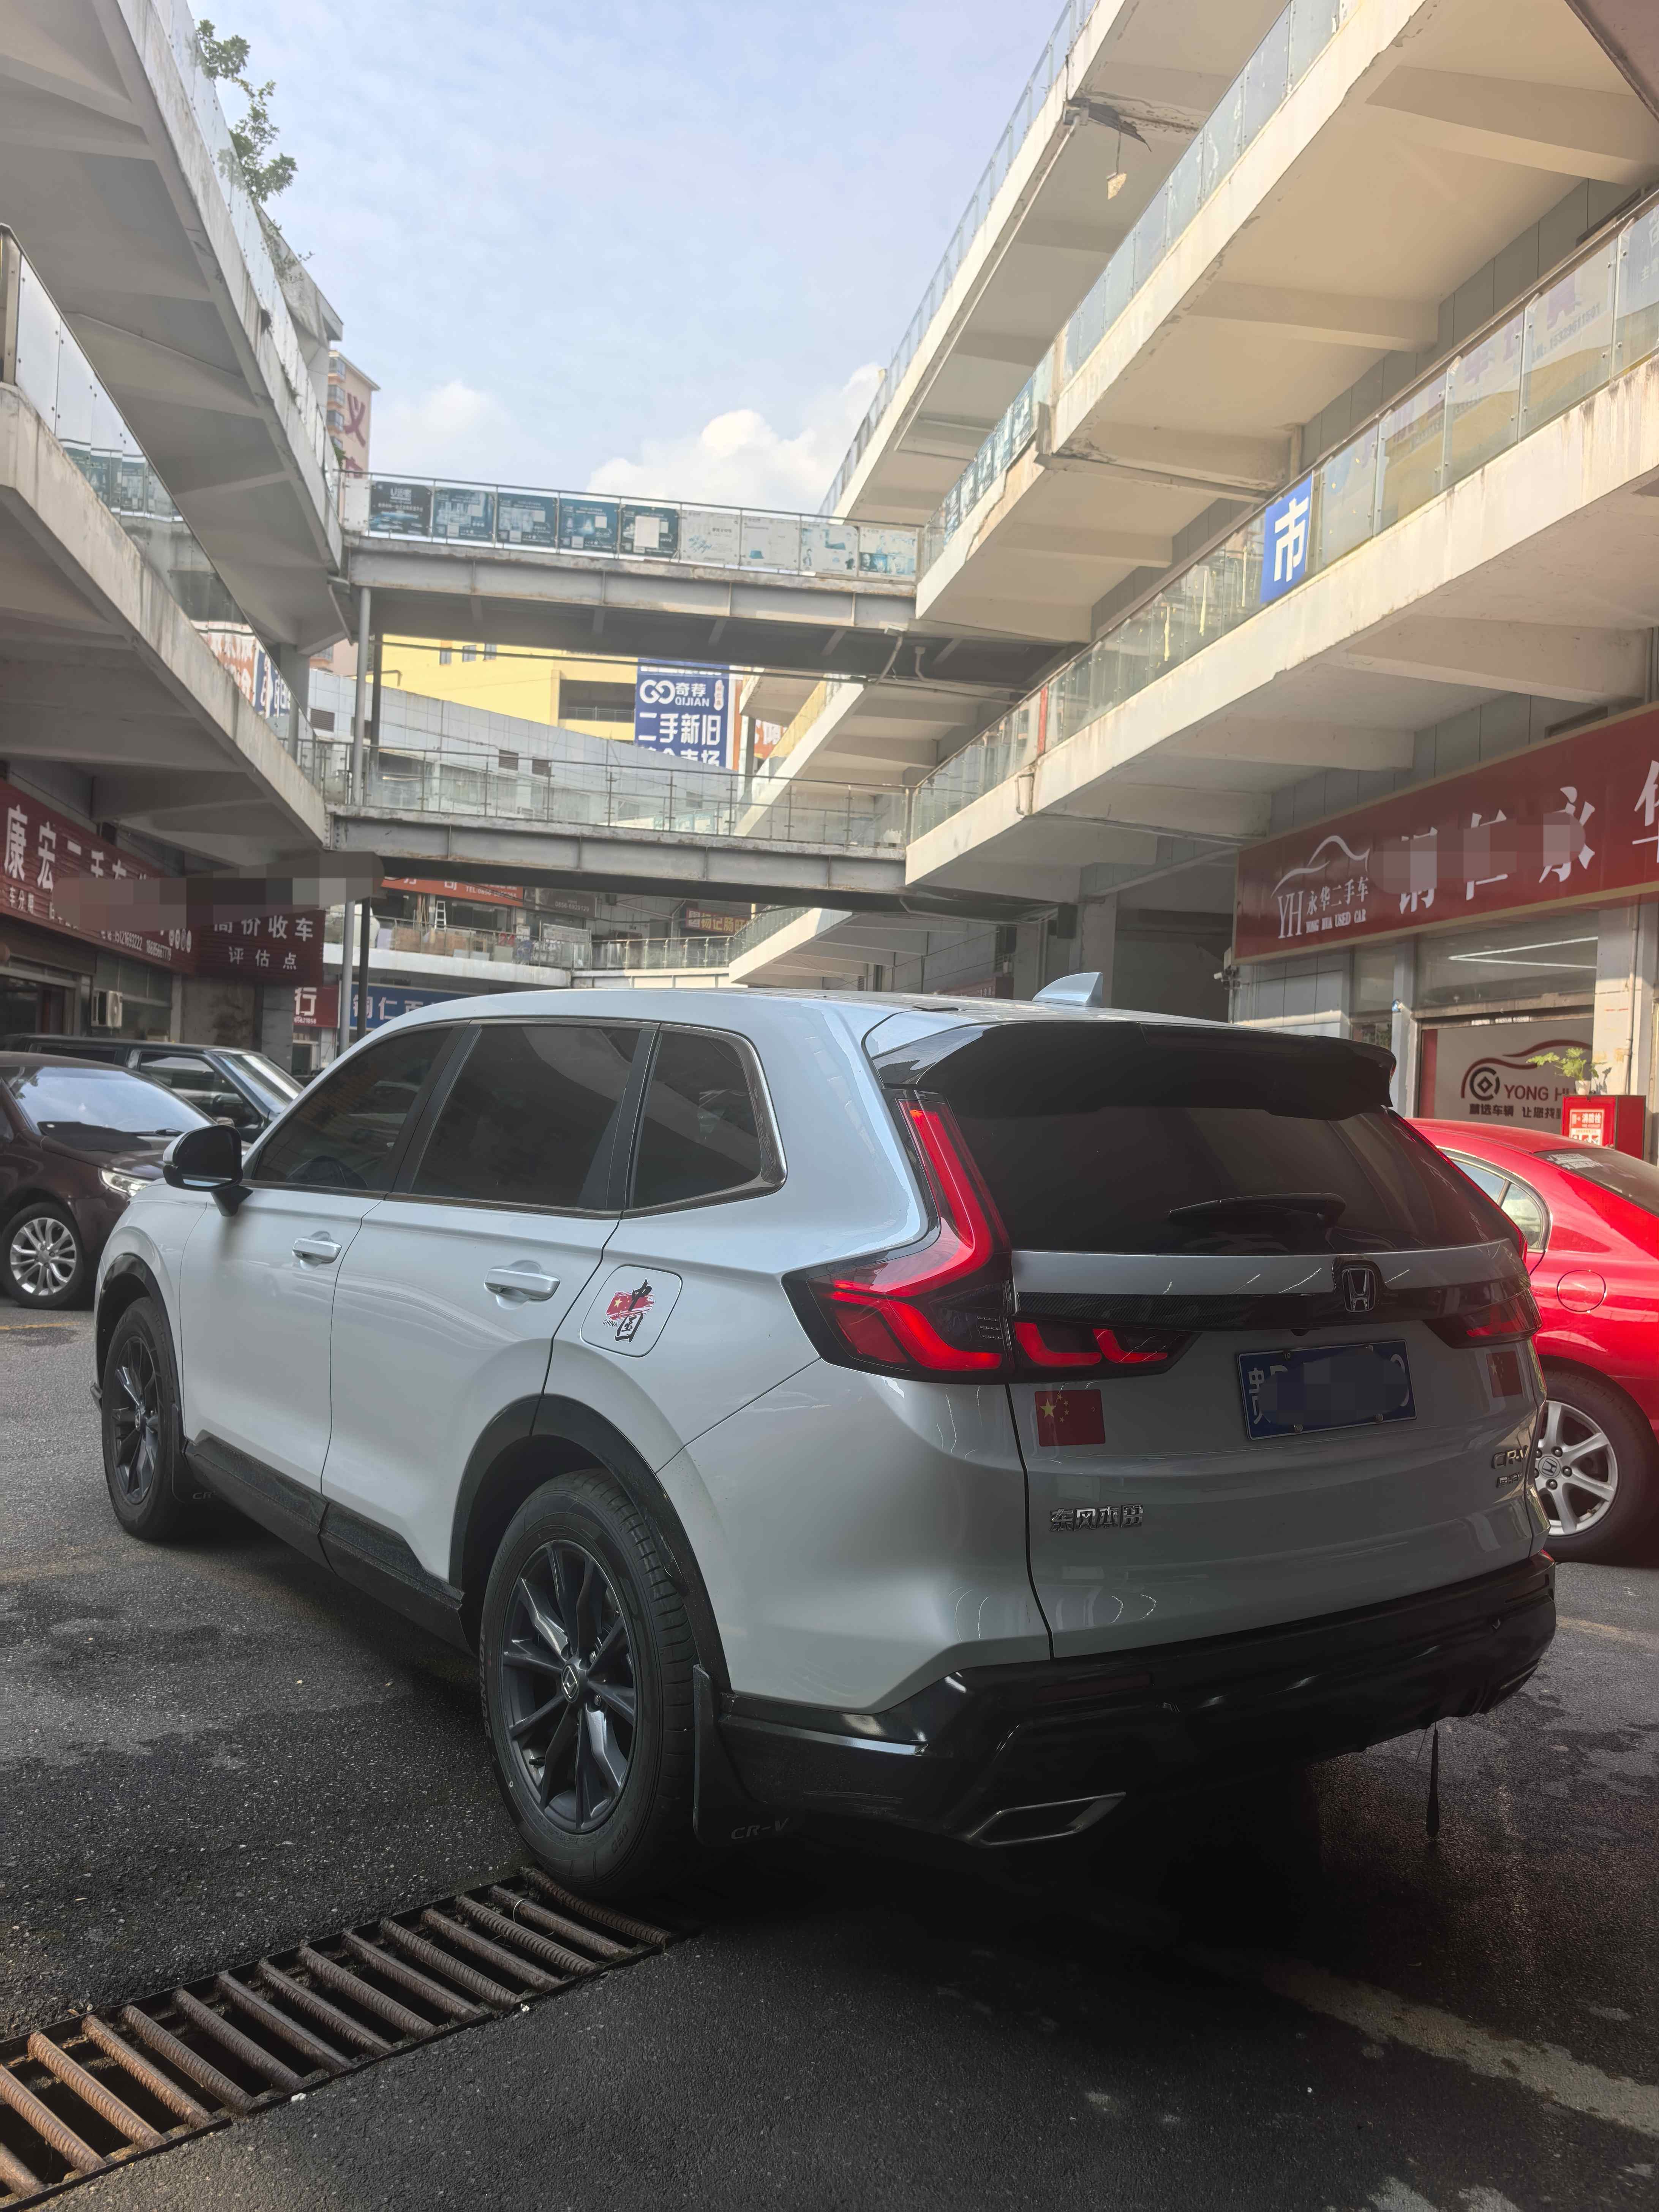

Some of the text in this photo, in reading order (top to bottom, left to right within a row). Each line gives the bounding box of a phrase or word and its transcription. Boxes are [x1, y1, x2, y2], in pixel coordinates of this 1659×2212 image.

[1274, 498, 1310, 582] 市
[675, 697, 709, 706] QIJIAN
[676, 683, 706, 697] 奇荐
[638, 713, 721, 745] 二手新旧
[1307, 875, 1370, 915] 永华二手车
[1277, 890, 1304, 939] YH
[1306, 919, 1319, 934] YONG
[1335, 911, 1351, 927] USED
[1354, 908, 1367, 923] CAR
[229, 946, 297, 970] 评估点
[294, 987, 317, 1016] 行
[1504, 1084, 1549, 1101] YONG
[603, 1318, 618, 1329] CHINA
[1492, 1446, 1528, 1470] CR-V
[1049, 1504, 1144, 1532] 东风本田
[731, 1817, 789, 1839] CR-V
